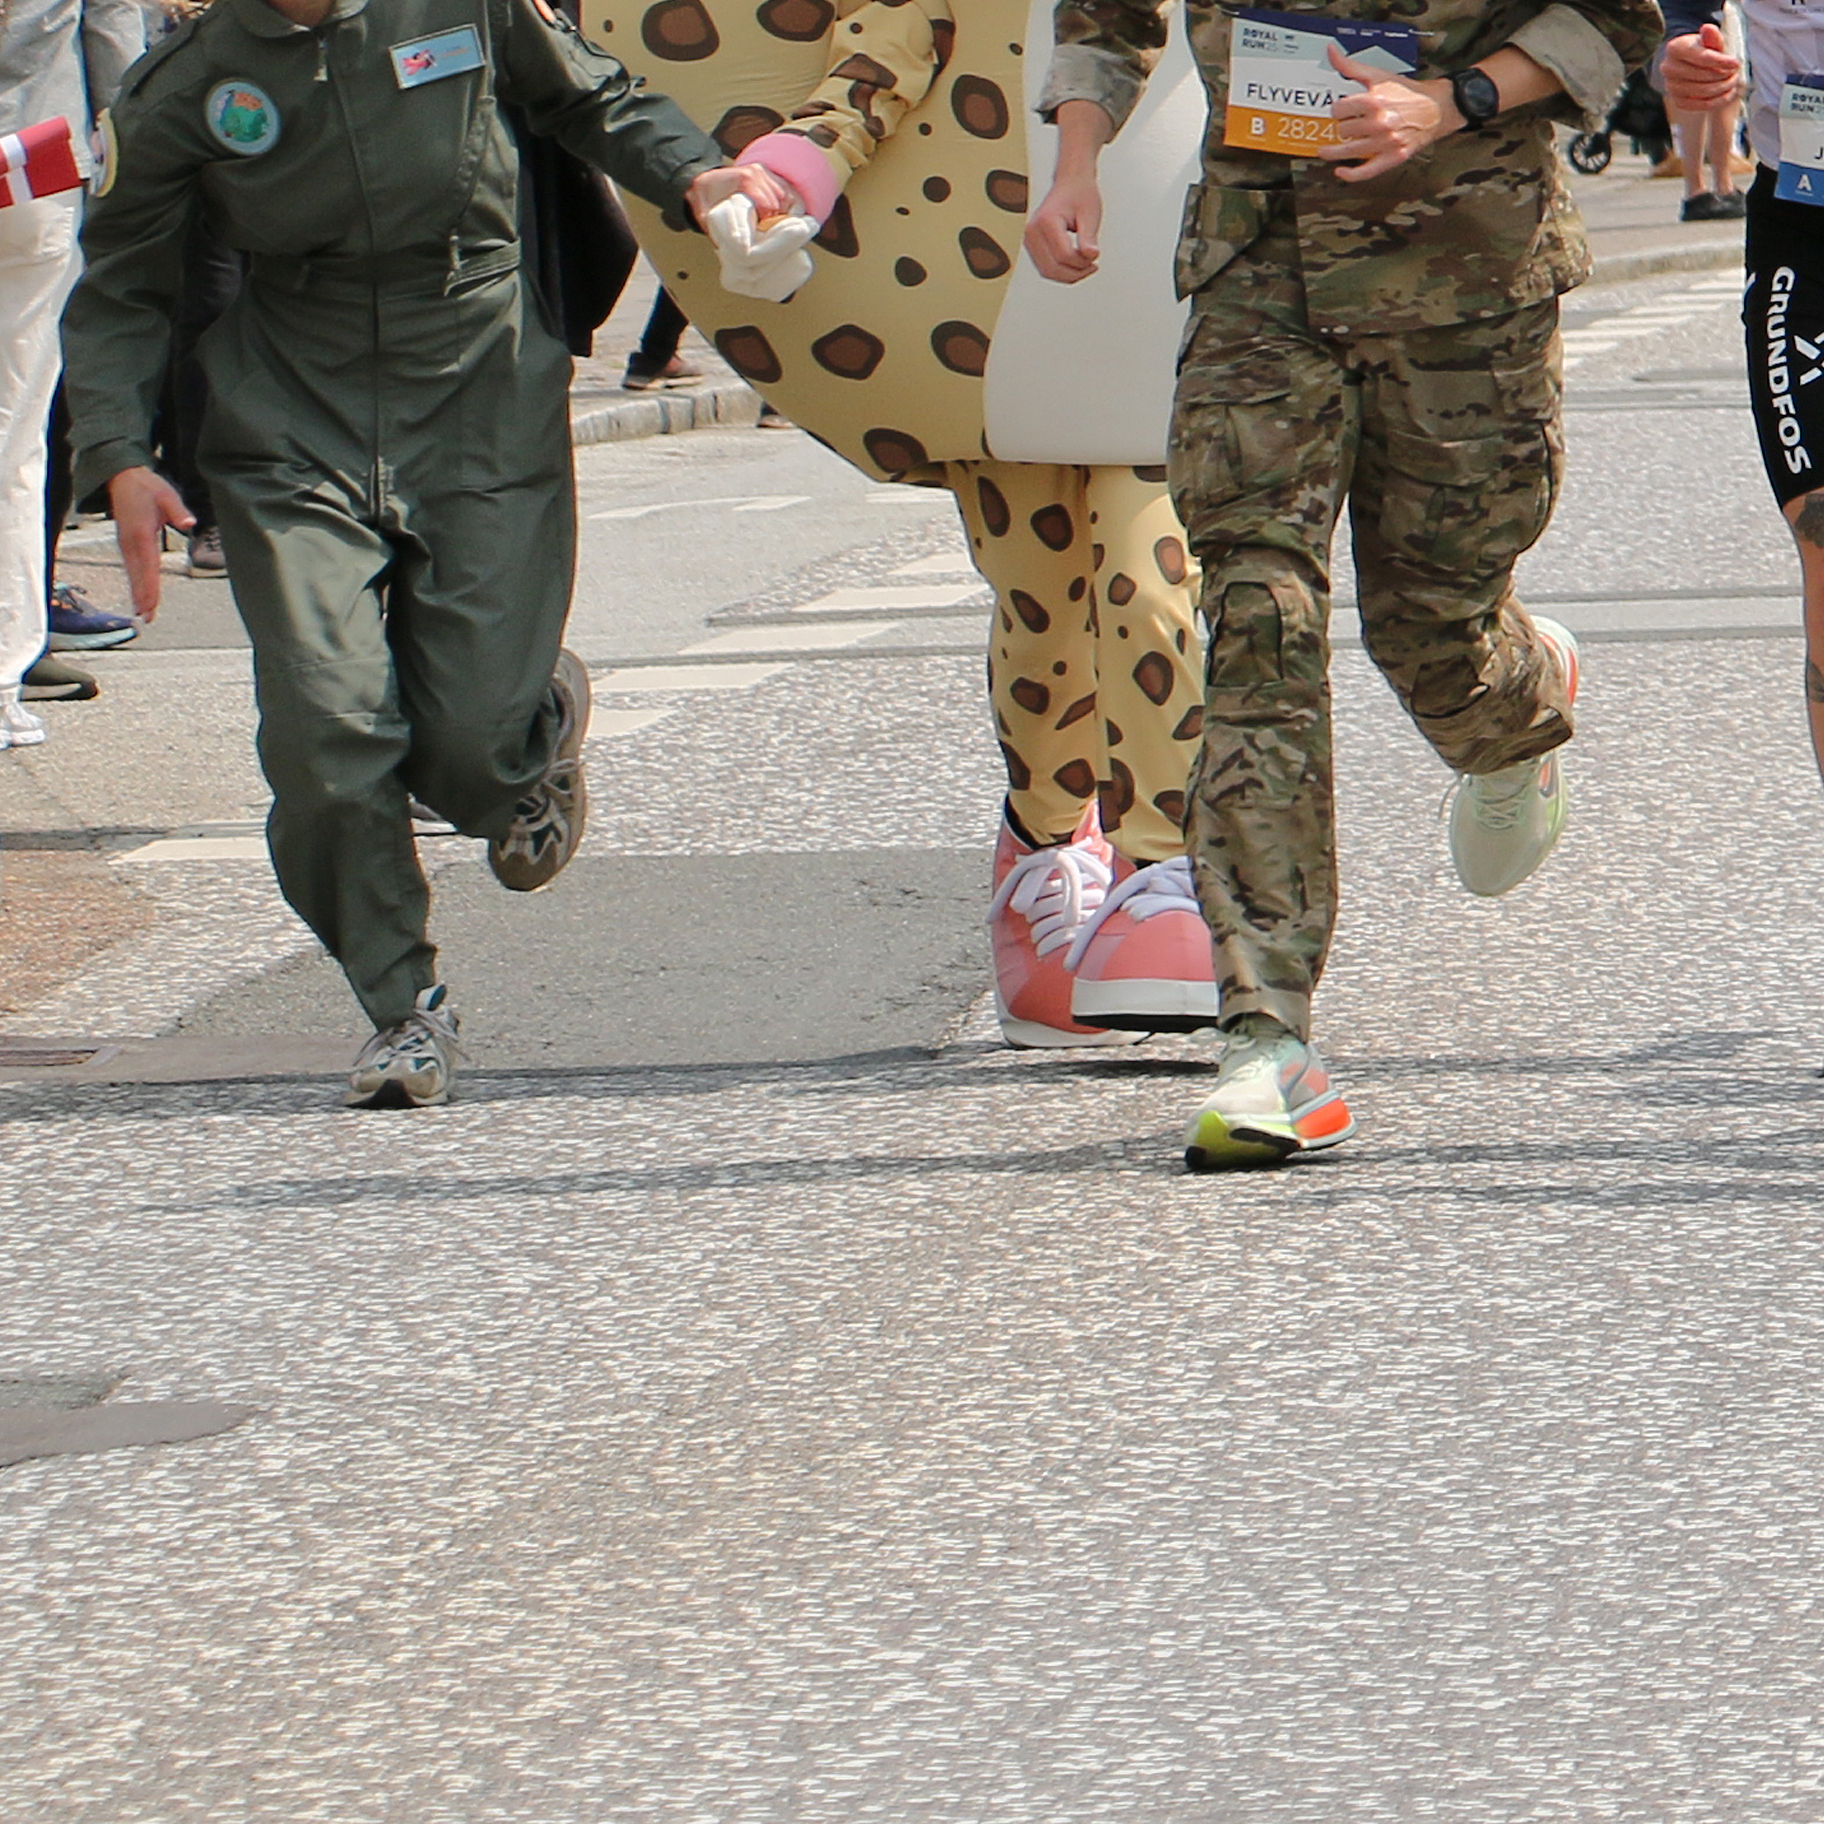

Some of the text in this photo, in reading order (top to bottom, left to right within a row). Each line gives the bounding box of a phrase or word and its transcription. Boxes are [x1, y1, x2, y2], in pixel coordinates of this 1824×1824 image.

[1251, 116, 1266, 136] B
[1797, 174, 1813, 192] A
[1766, 266, 1812, 475] GRUNDFOS
